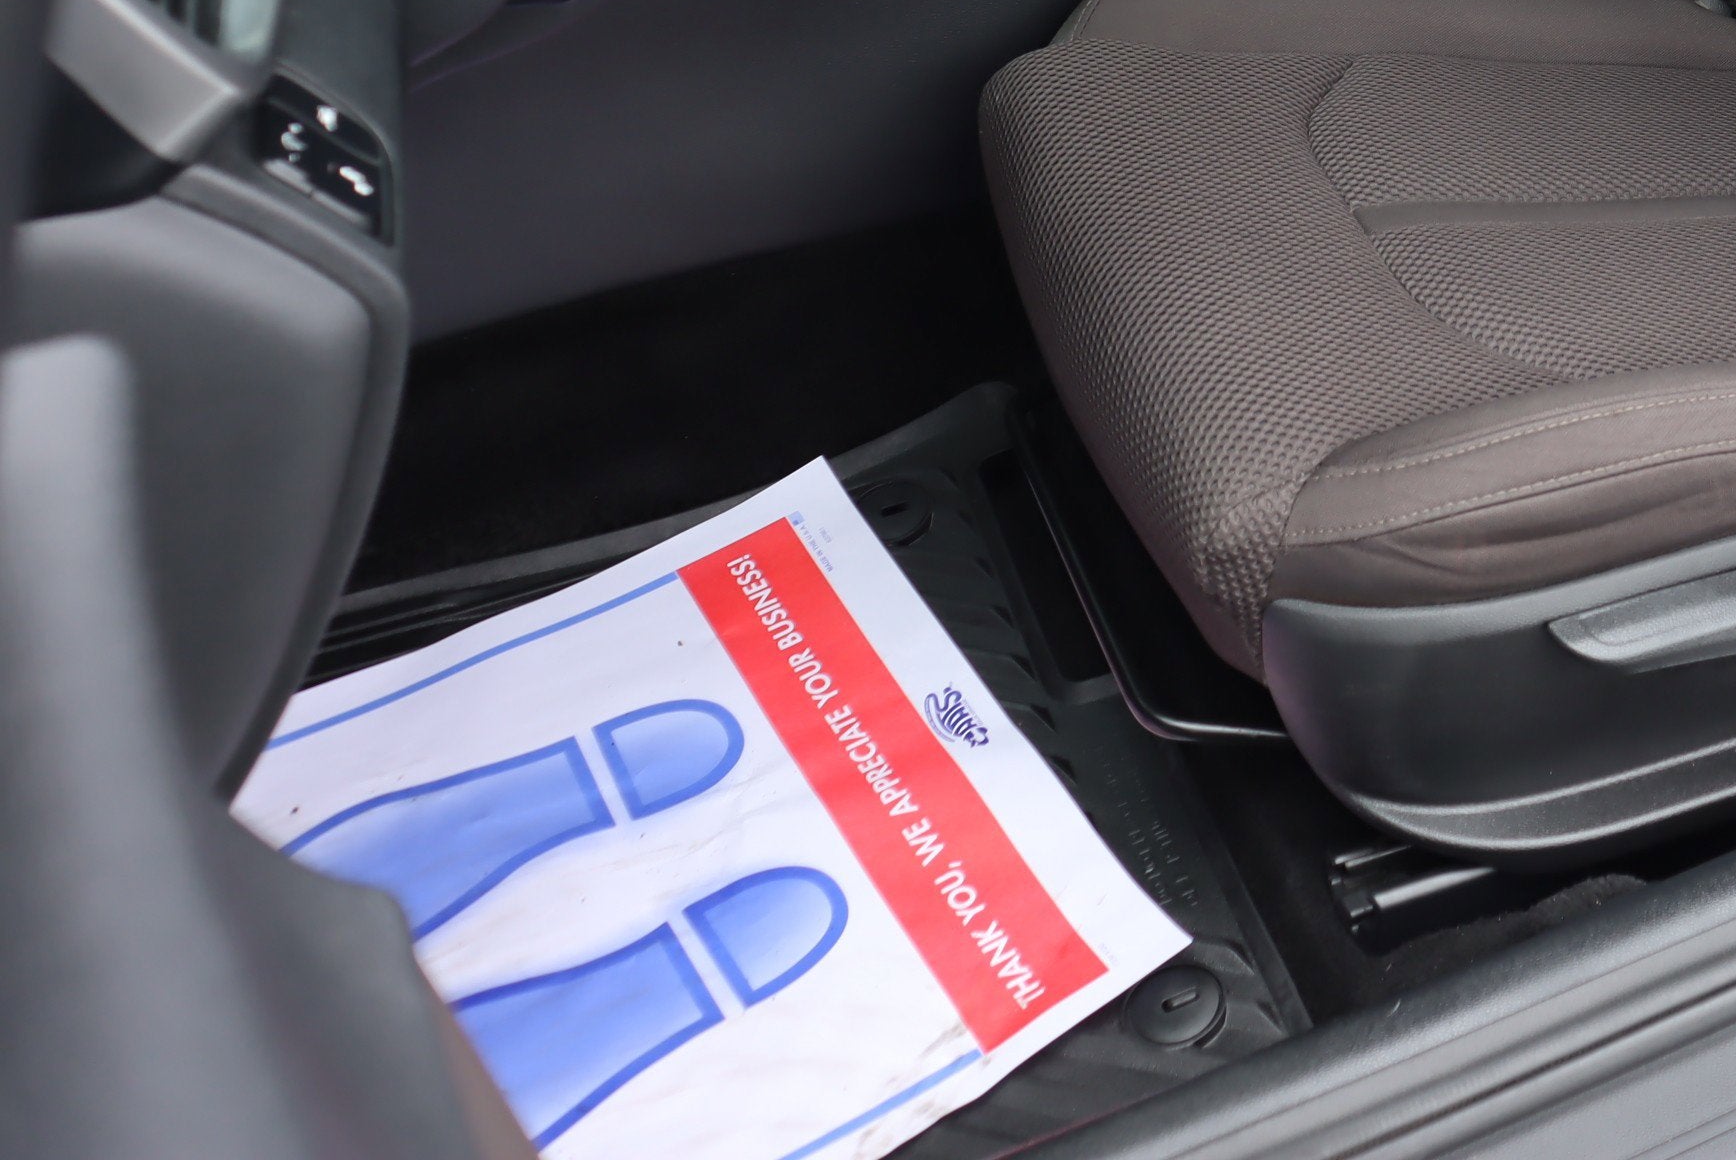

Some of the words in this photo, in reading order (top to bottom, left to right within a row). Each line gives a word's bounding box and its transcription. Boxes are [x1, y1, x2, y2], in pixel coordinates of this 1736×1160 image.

[728, 555, 802, 650] BUSINESS!
[789, 648, 838, 708] YOUR
[825, 706, 918, 816] APPRECIATE
[902, 818, 944, 866] WE
[935, 861, 985, 925] YOU,
[972, 921, 1043, 1008] THANK
